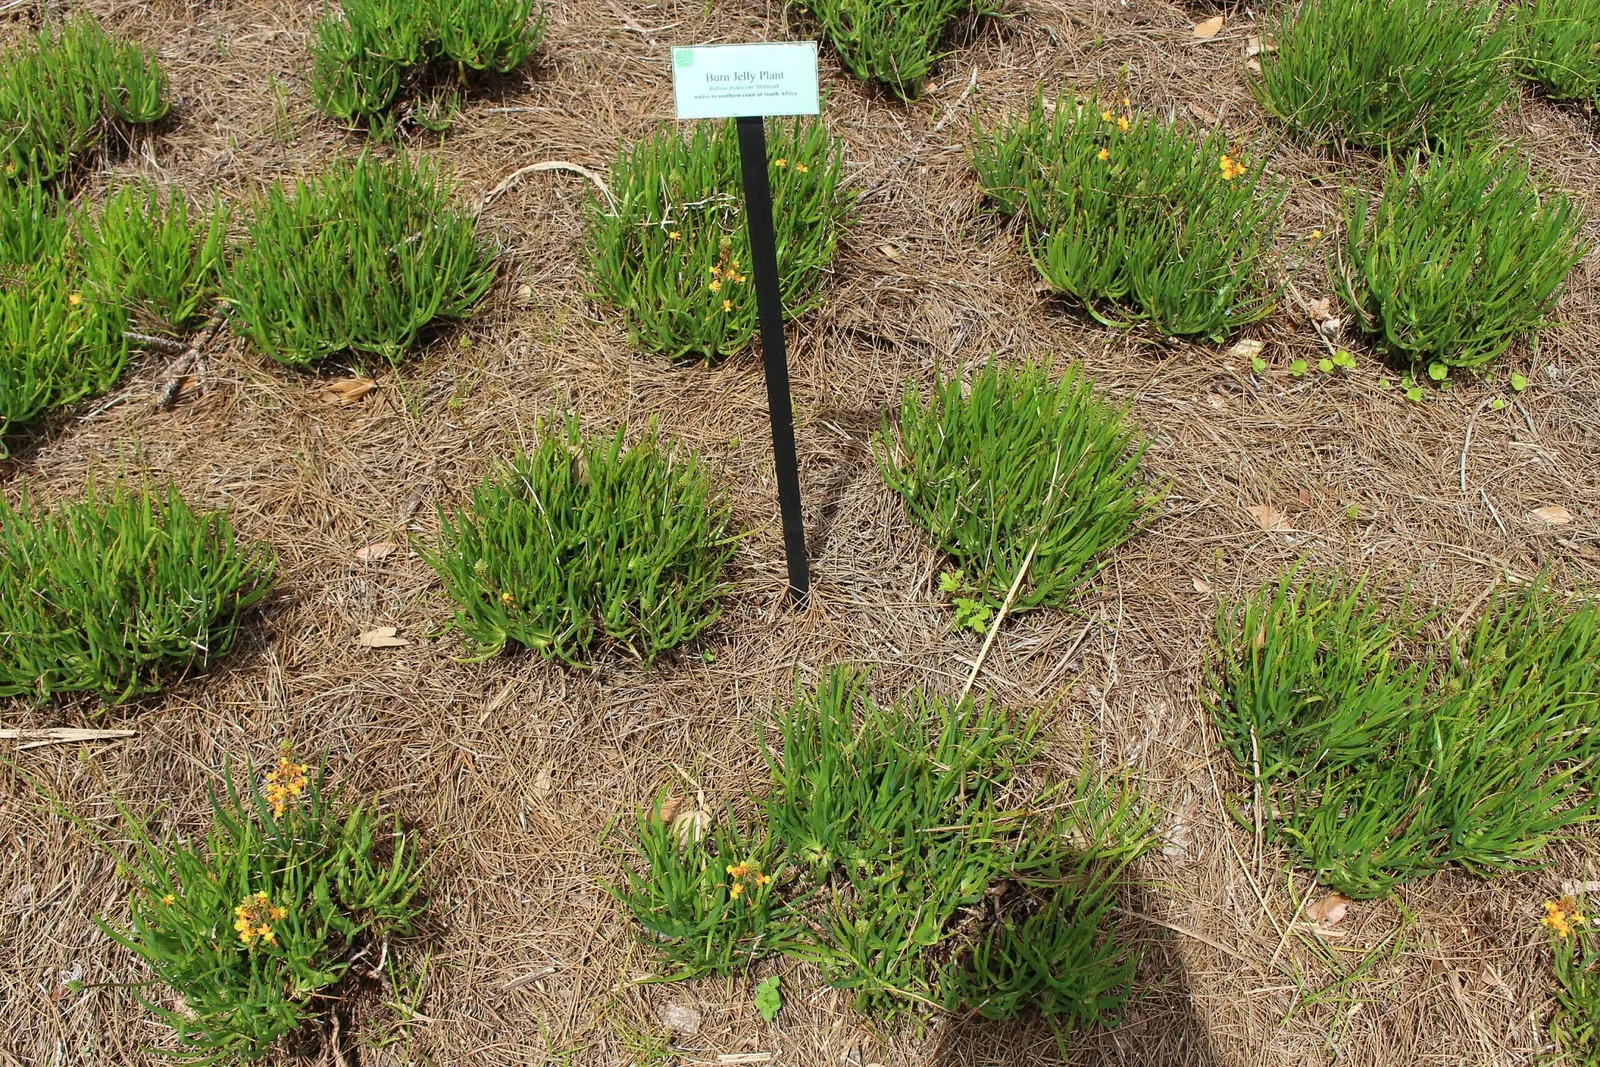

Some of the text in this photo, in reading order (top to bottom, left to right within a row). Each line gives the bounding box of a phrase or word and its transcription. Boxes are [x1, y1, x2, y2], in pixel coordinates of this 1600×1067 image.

[705, 70, 784, 83] Burn Jelly Plant
